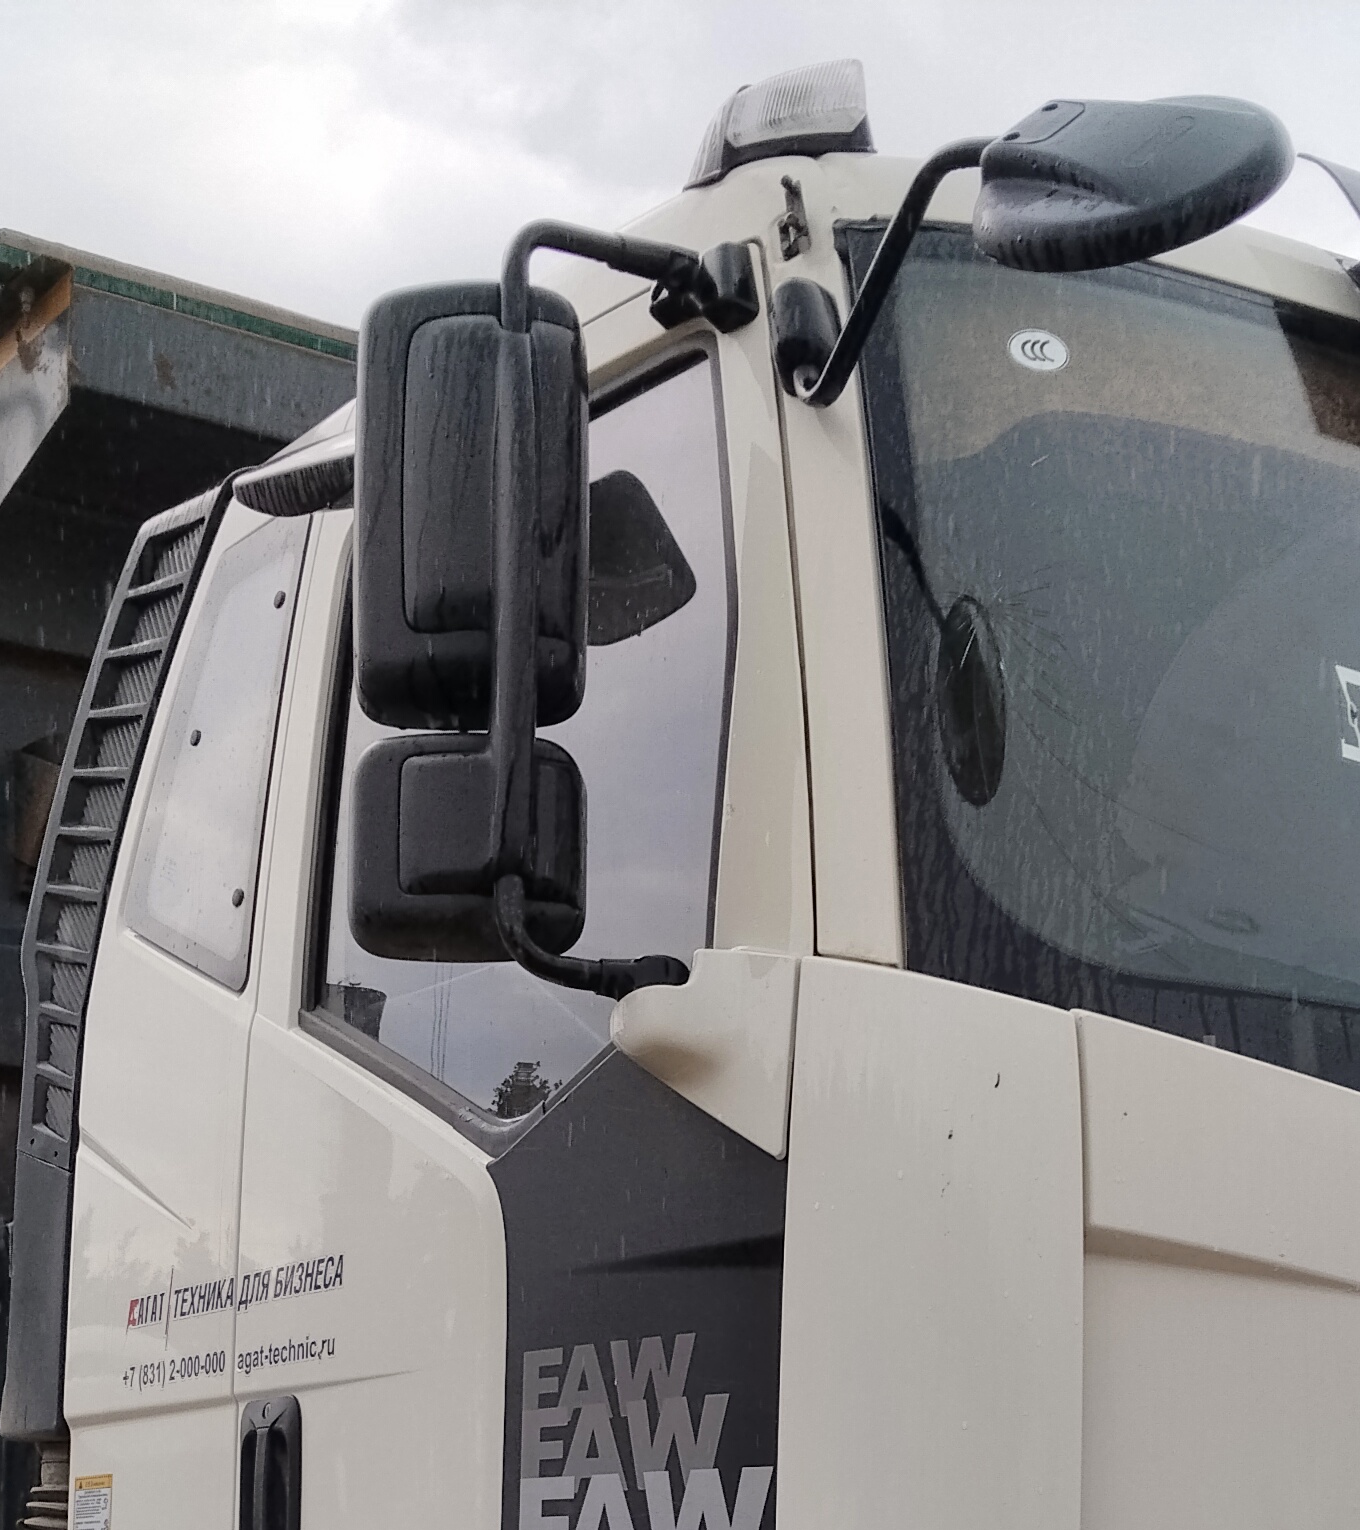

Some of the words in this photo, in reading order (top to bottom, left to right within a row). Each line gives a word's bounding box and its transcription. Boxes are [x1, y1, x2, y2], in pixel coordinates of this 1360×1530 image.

[173, 1277, 235, 1319] ТЕХНИКА
[237, 1269, 272, 1312] ДЛЯ
[273, 1254, 344, 1299] БИЗНЕСА
[122, 1366, 136, 1387] +7
[138, 1360, 166, 1392] (831)
[168, 1350, 226, 1381] 2-000-000
[237, 1335, 336, 1375] agat-technic.ru
[523, 1333, 697, 1418] FAW
[520, 1393, 730, 1491] FAW
